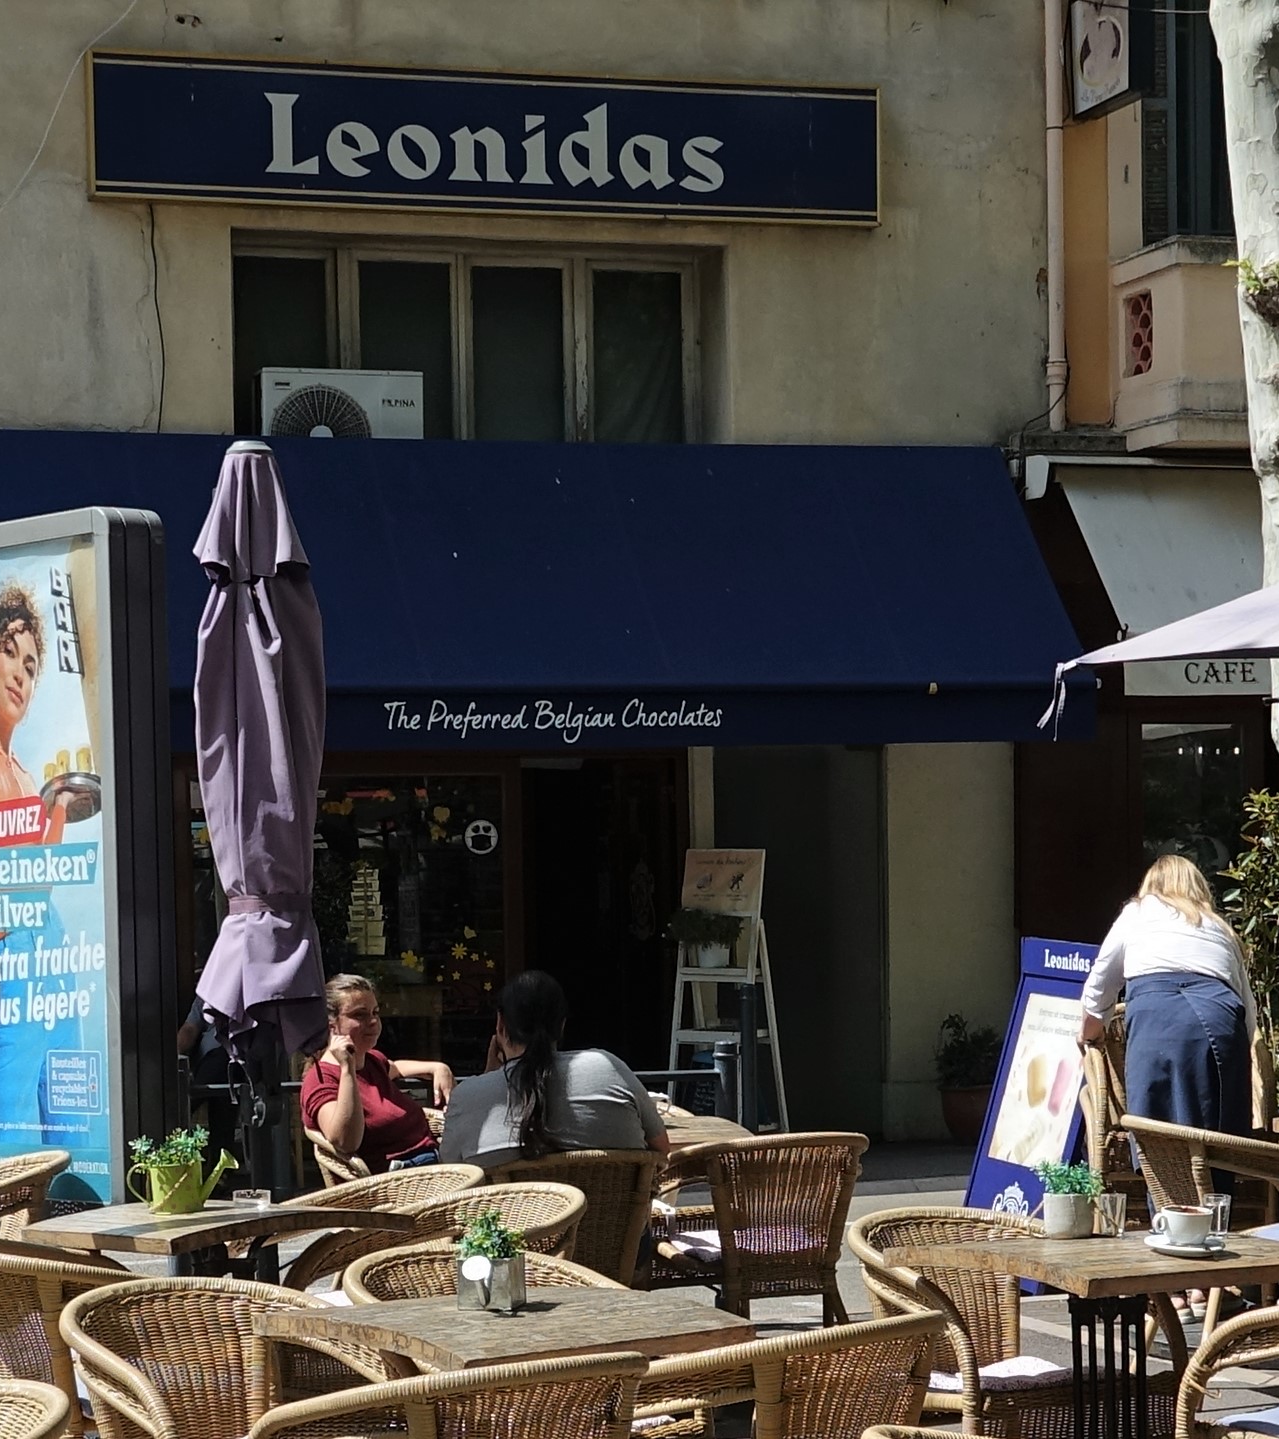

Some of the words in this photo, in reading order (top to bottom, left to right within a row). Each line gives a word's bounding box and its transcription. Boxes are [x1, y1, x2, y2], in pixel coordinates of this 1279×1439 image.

[263, 91, 726, 194] Leonidas
[384, 701, 421, 730] The
[426, 699, 530, 739] Preferred
[534, 699, 617, 744] Belgian
[622, 698, 723, 728] Chocolates
[34, 930, 106, 977] fraîche
[1044, 948, 1091, 973] Leonidas
[51, 1056, 87, 1068] Bouteilles
[58, 1070, 87, 1083] capsules
[52, 1095, 88, 1107] Trions-les
